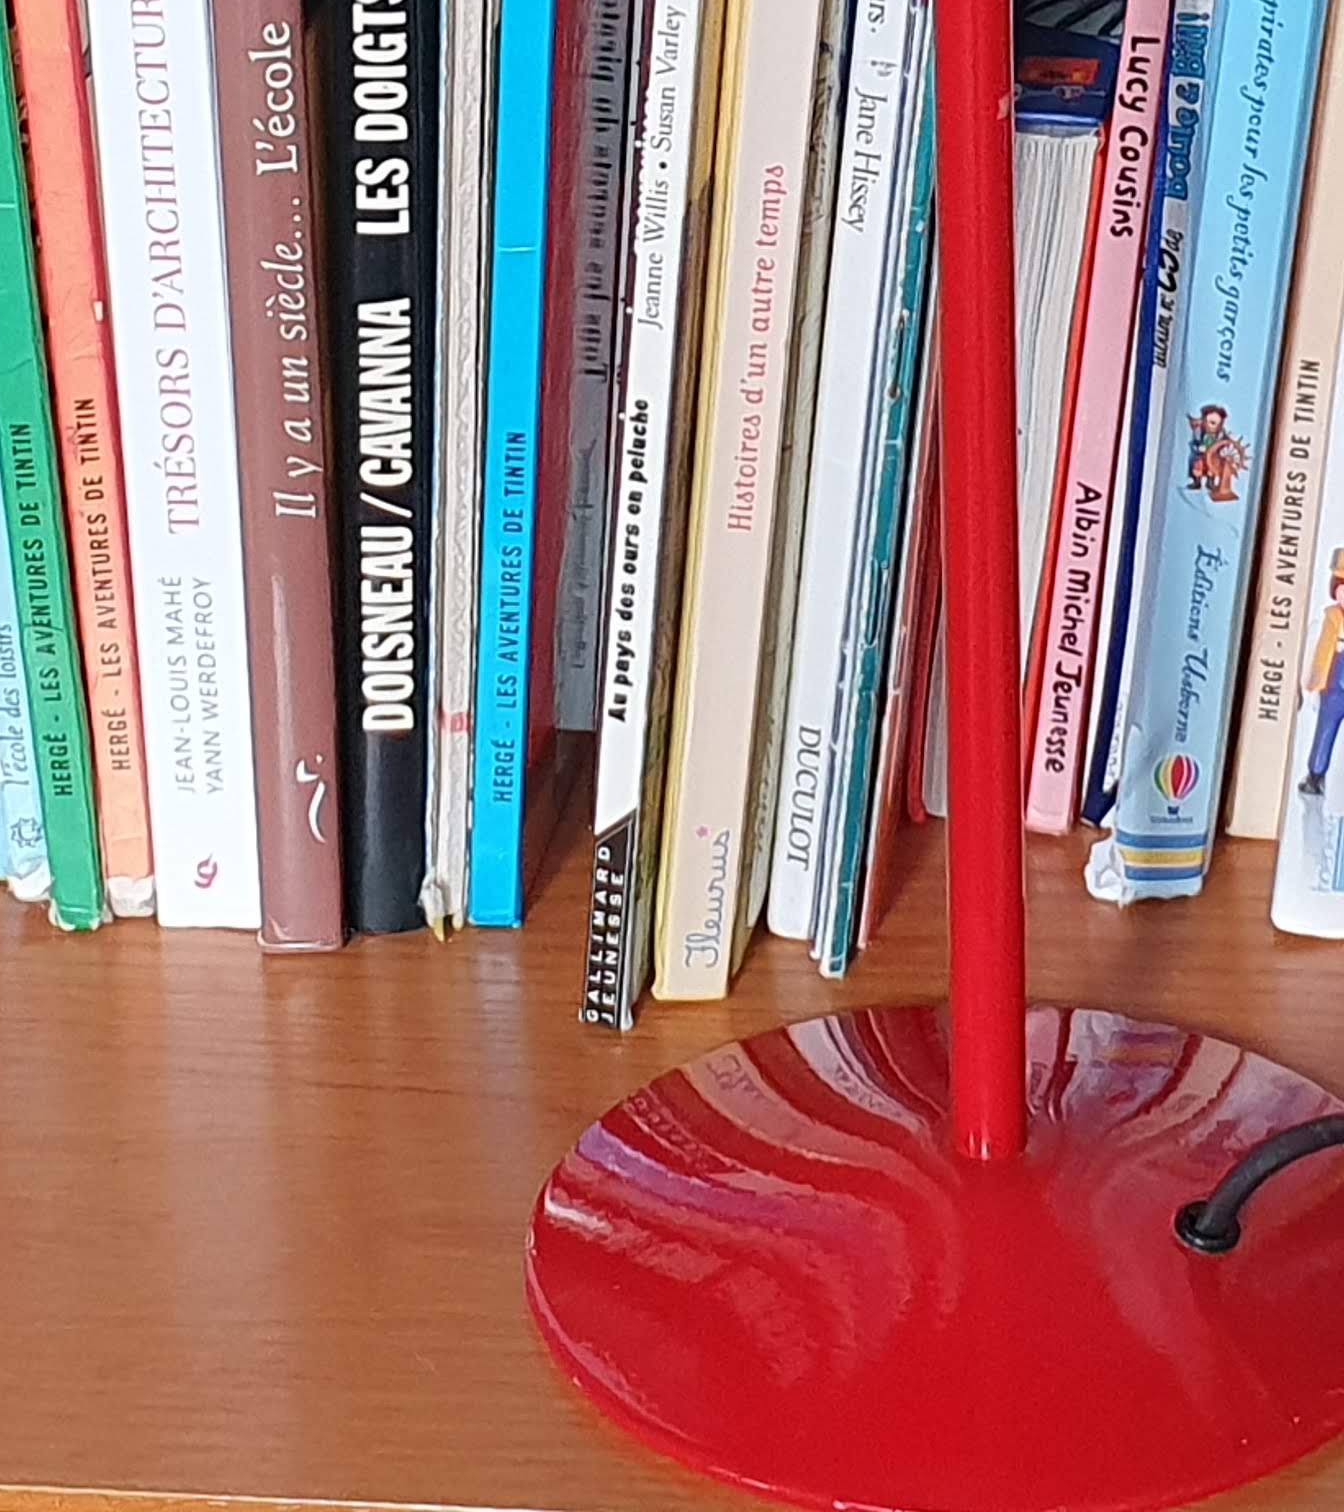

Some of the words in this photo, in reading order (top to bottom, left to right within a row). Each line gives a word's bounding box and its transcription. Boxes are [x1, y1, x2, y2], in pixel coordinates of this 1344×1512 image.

[654, 5, 685, 76] Varley
[1117, 34, 1160, 113] Lucy
[246, 20, 297, 174] L'école
[650, 87, 676, 153] Susan
[849, 86, 888, 145] Jane
[353, 157, 411, 236] LES
[642, 178, 668, 244] Willis
[754, 163, 789, 249] temps
[840, 148, 881, 231] Hissey
[1108, 124, 1149, 239] Cousins
[1215, 199, 1260, 283] petits
[636, 251, 666, 330] Jeanne
[748, 256, 776, 333] autre
[1202, 284, 1245, 383] garçons
[280, 356, 309, 402] un
[357, 297, 413, 486] CAVANNA
[737, 339, 768, 405] d'un
[1292, 359, 1320, 423] TINTIN
[9, 423, 36, 489] TINTIN
[73, 396, 100, 463] TINTIN
[146, 345, 200, 534] TRÉSORS
[282, 416, 312, 443] a
[284, 452, 322, 478] y
[502, 431, 526, 497] TINTIN
[623, 398, 653, 484] peluche
[1289, 434, 1310, 459] DE
[82, 475, 103, 499] DE
[273, 490, 316, 519] Il
[726, 411, 762, 531] Histoires
[18, 500, 41, 525] DE
[502, 508, 522, 532] DE
[621, 522, 639, 574] ours
[1067, 482, 1103, 558] Albin
[1274, 469, 1306, 585] AVENTURES
[21, 537, 56, 655] AVENTURES
[85, 512, 116, 630] AVENTURES
[497, 546, 522, 661] AVENTURES
[615, 582, 634, 621] des
[1183, 544, 1230, 644] Éditions
[157, 575, 185, 645] MAHÉ
[190, 574, 218, 720] WERDEFROY
[358, 524, 416, 730] DOISNEAU
[1056, 569, 1093, 656] Michel
[1268, 596, 1292, 630] LES
[39, 667, 60, 702] LES
[99, 641, 121, 676] LES
[496, 674, 517, 708] LES
[612, 629, 636, 686] pays
[1171, 646, 1211, 744] Usborne
[166, 654, 195, 794] JEAN-LOUIS
[607, 692, 628, 722] Au
[1042, 660, 1083, 774] Jeunesse
[201, 730, 223, 793] YANN
[786, 725, 822, 871] DUCULOT
[587, 846, 610, 1021] GALLIMARD
[600, 872, 623, 1023] JEUNESSE
